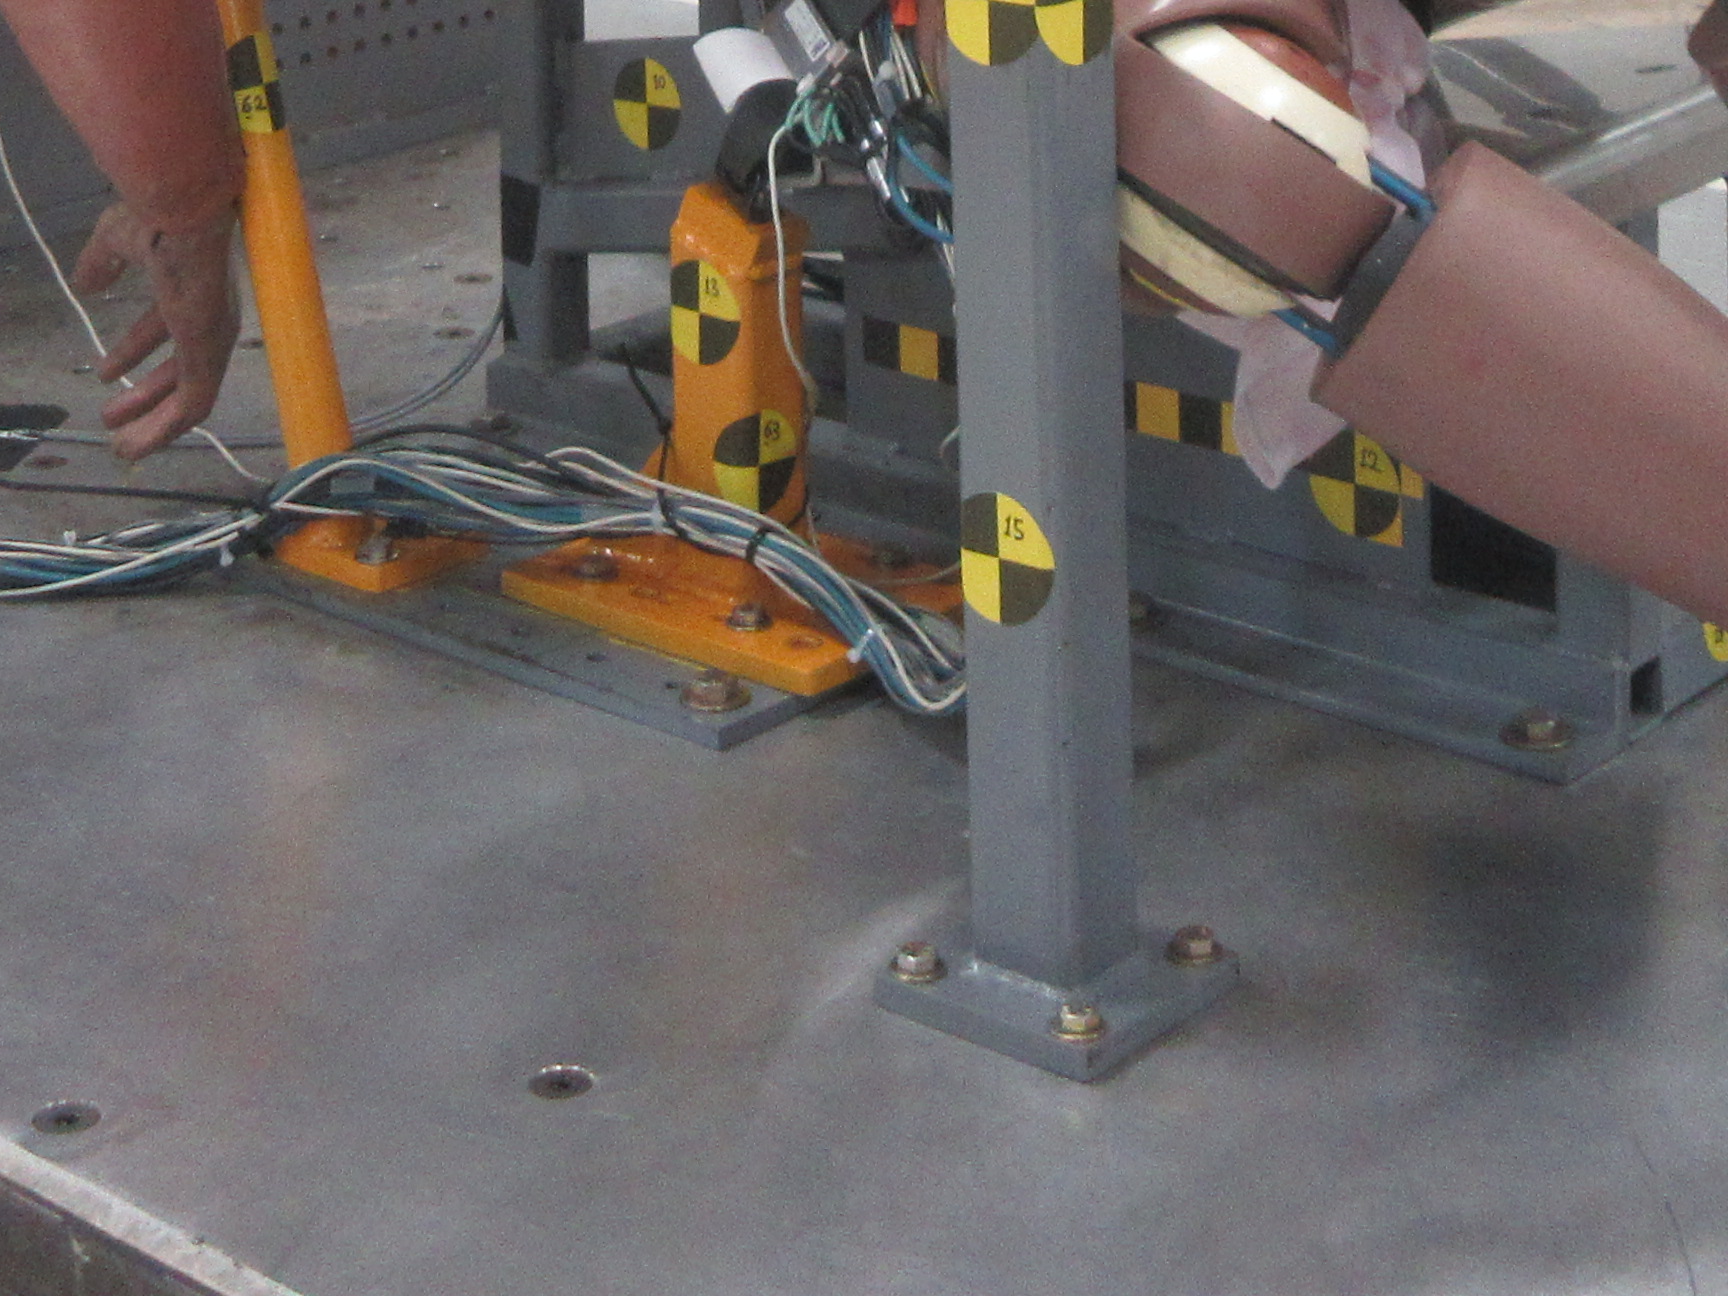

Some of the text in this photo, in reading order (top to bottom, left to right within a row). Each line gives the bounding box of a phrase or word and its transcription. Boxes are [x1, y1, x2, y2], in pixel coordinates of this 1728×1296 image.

[242, 95, 267, 115] 62
[704, 275, 721, 297] 13
[1003, 514, 1025, 541] 15
